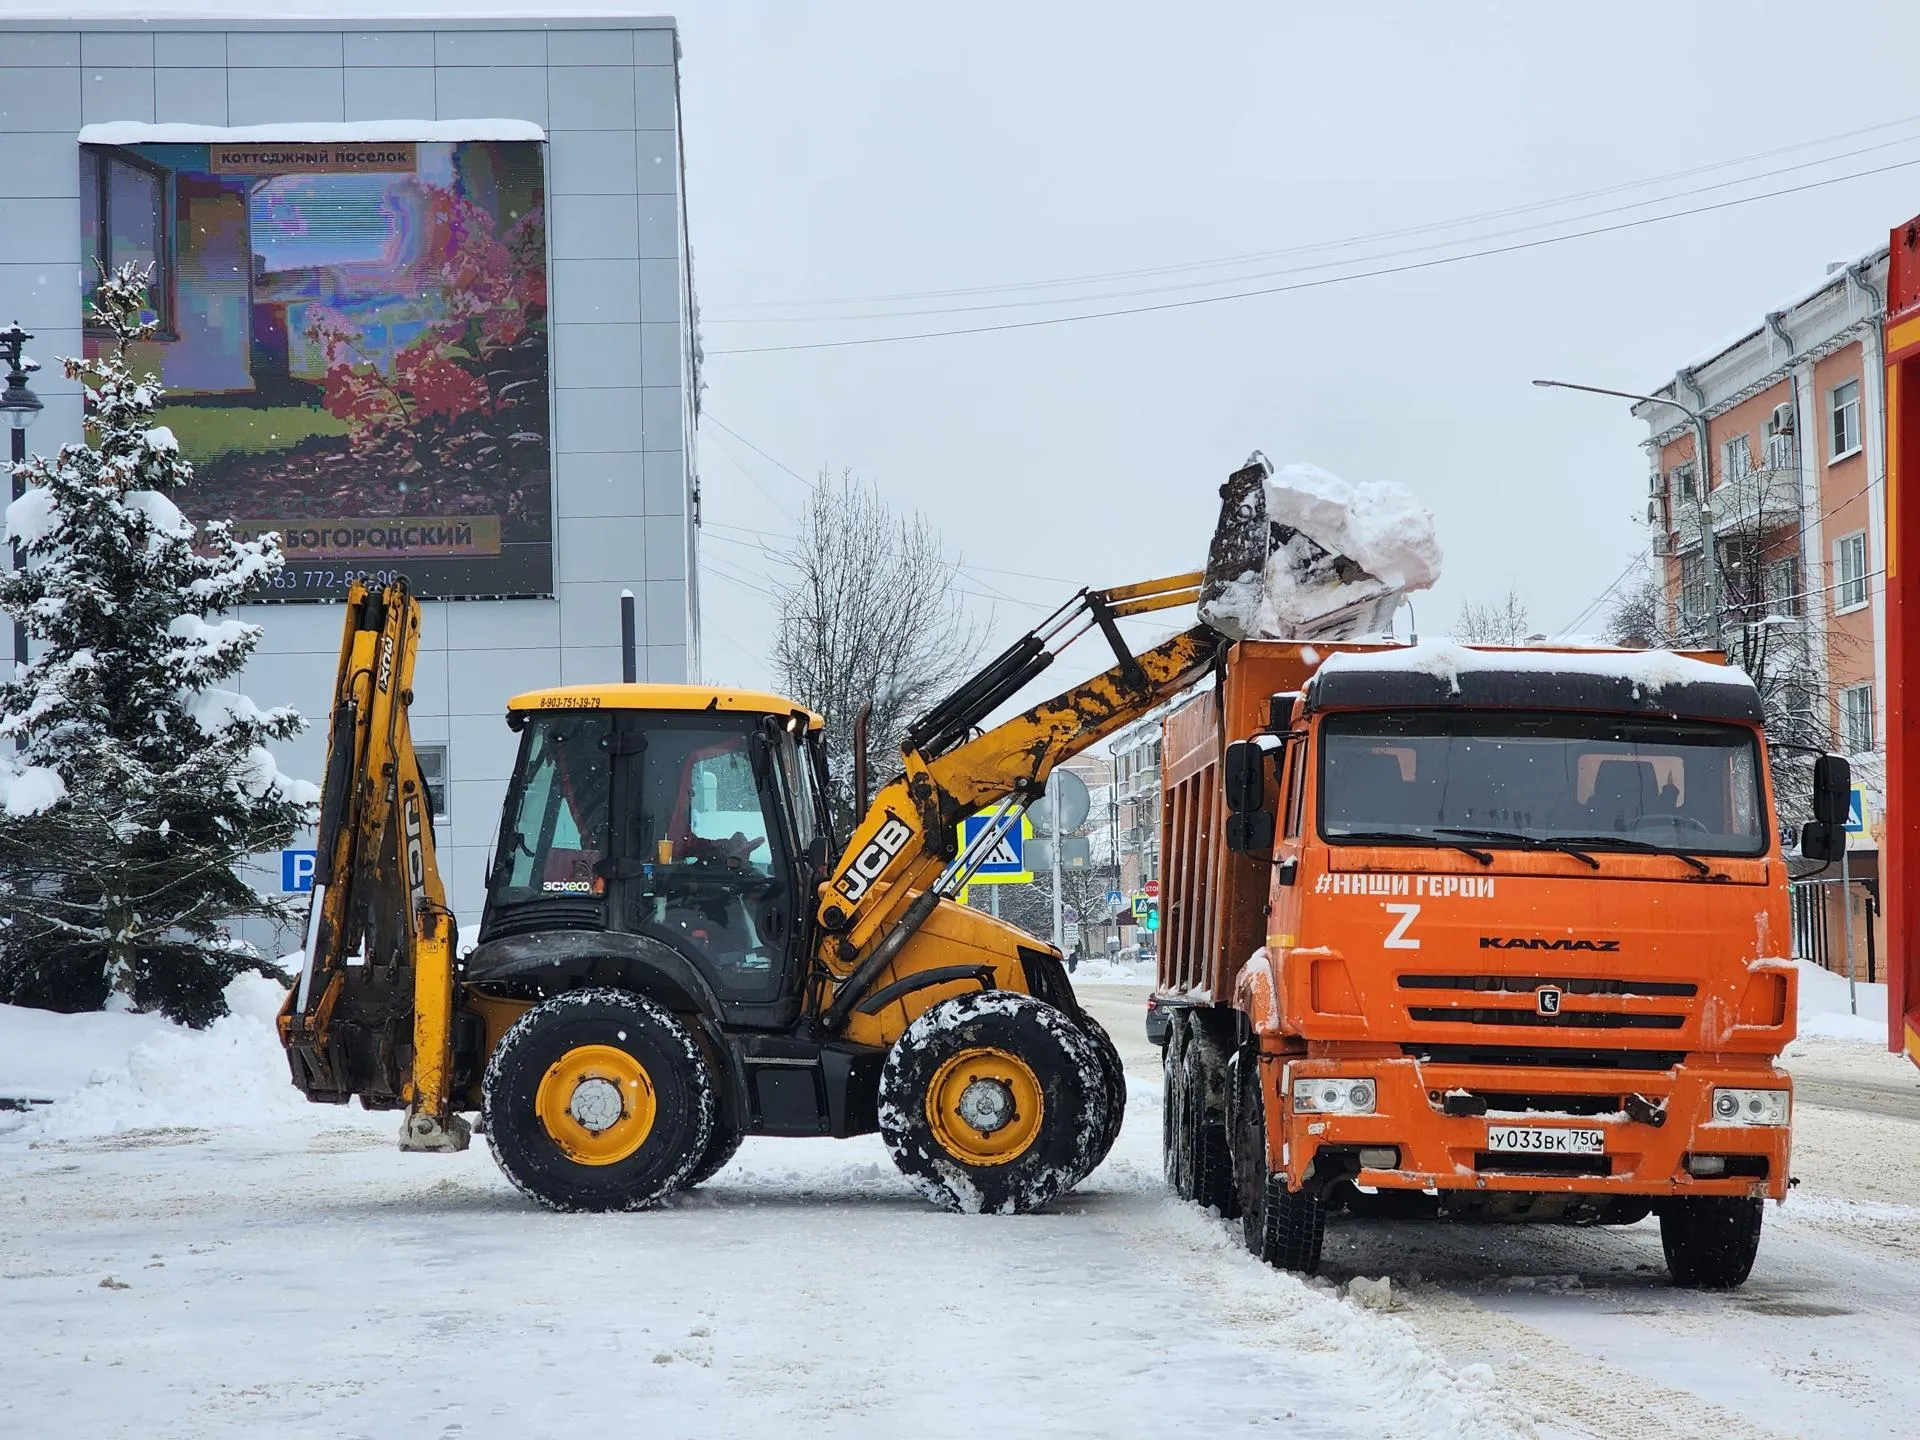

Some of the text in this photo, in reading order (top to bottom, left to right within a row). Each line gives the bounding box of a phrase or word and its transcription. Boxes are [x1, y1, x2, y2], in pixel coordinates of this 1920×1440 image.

[335, 150, 407, 163] поселок
[286, 523, 473, 549] БОГОРОДСКИЙ
[266, 570, 297, 589] 63
[540, 697, 601, 708] 8-903-751-39-79
[845, 820, 910, 900] JCB
[294, 854, 316, 888] P
[542, 881, 590, 892] 3CXeco
[1315, 873, 1495, 898] #НАШИ ГЕРОИ
[1383, 903, 1421, 949] Z
[1480, 937, 1620, 952] KAMAZ
[1571, 1131, 1599, 1146] 750
